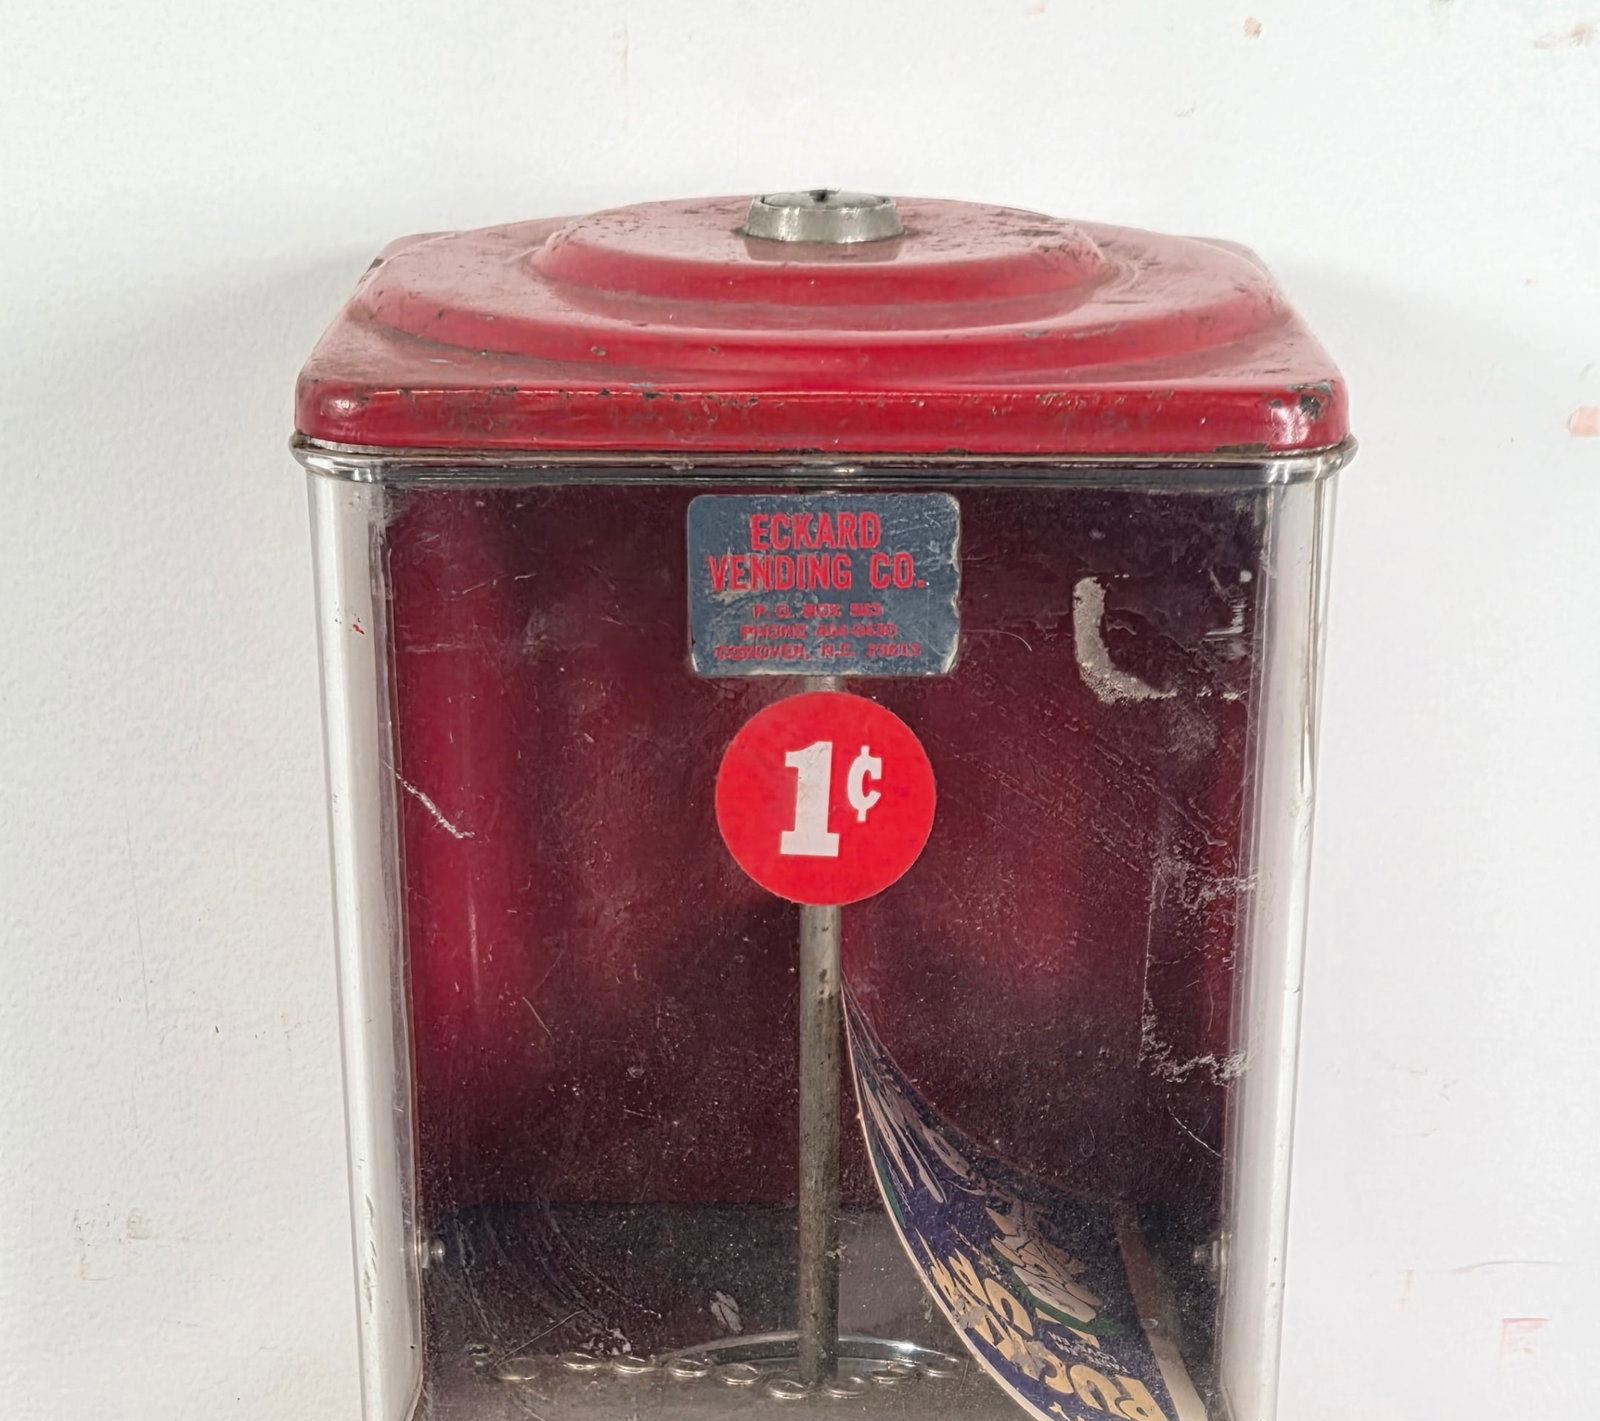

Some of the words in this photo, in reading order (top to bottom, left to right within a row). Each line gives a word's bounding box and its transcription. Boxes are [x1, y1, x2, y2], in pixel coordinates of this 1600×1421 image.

[749, 512, 882, 550] ECKARD
[708, 553, 852, 592] VENDING
[870, 551, 926, 588] CO.
[803, 603, 842, 618] BOX
[741, 624, 807, 639] PHONE
